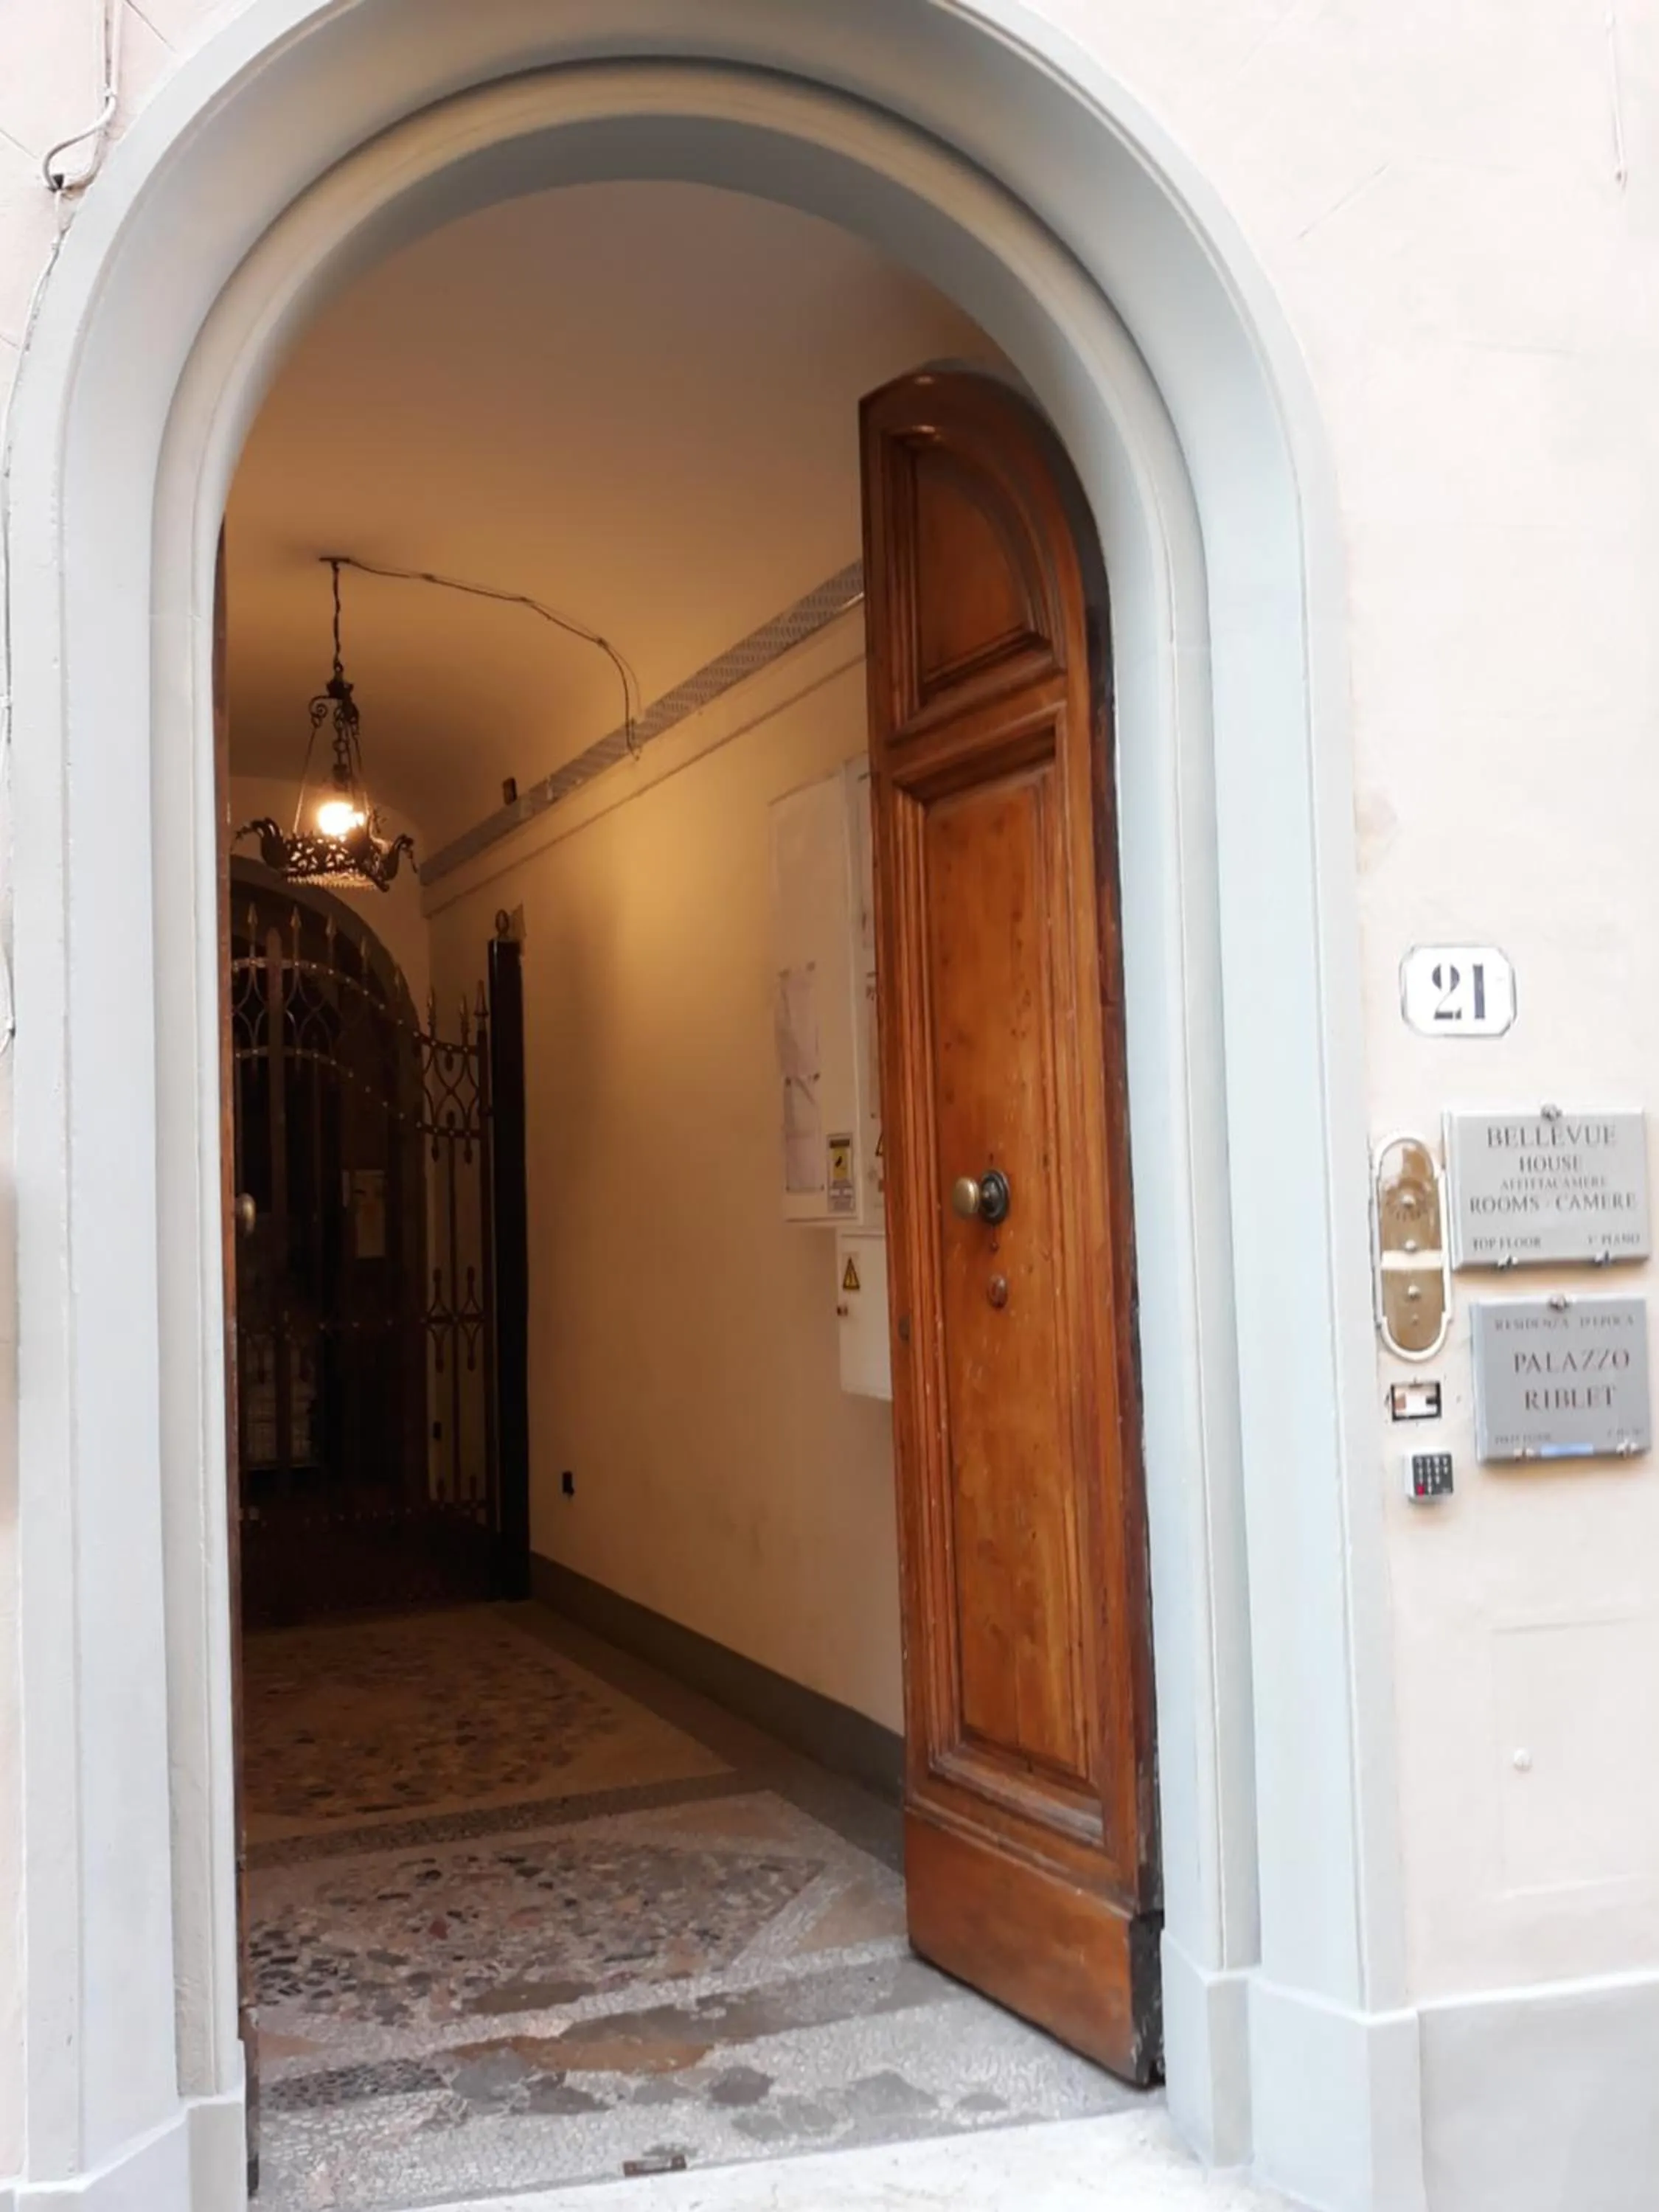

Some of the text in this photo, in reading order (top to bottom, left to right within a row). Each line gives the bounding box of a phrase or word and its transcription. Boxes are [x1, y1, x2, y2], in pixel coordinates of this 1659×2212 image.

[1432, 963, 1486, 1020] 21
[1487, 1125, 1615, 1148] BELLEVUE
[1519, 1155, 1582, 1174] HOUSE
[1470, 1192, 1637, 1215] ROOMS CAMERE
[1514, 1349, 1631, 1374] PALAZZO
[1524, 1385, 1618, 1411] RIBLET
